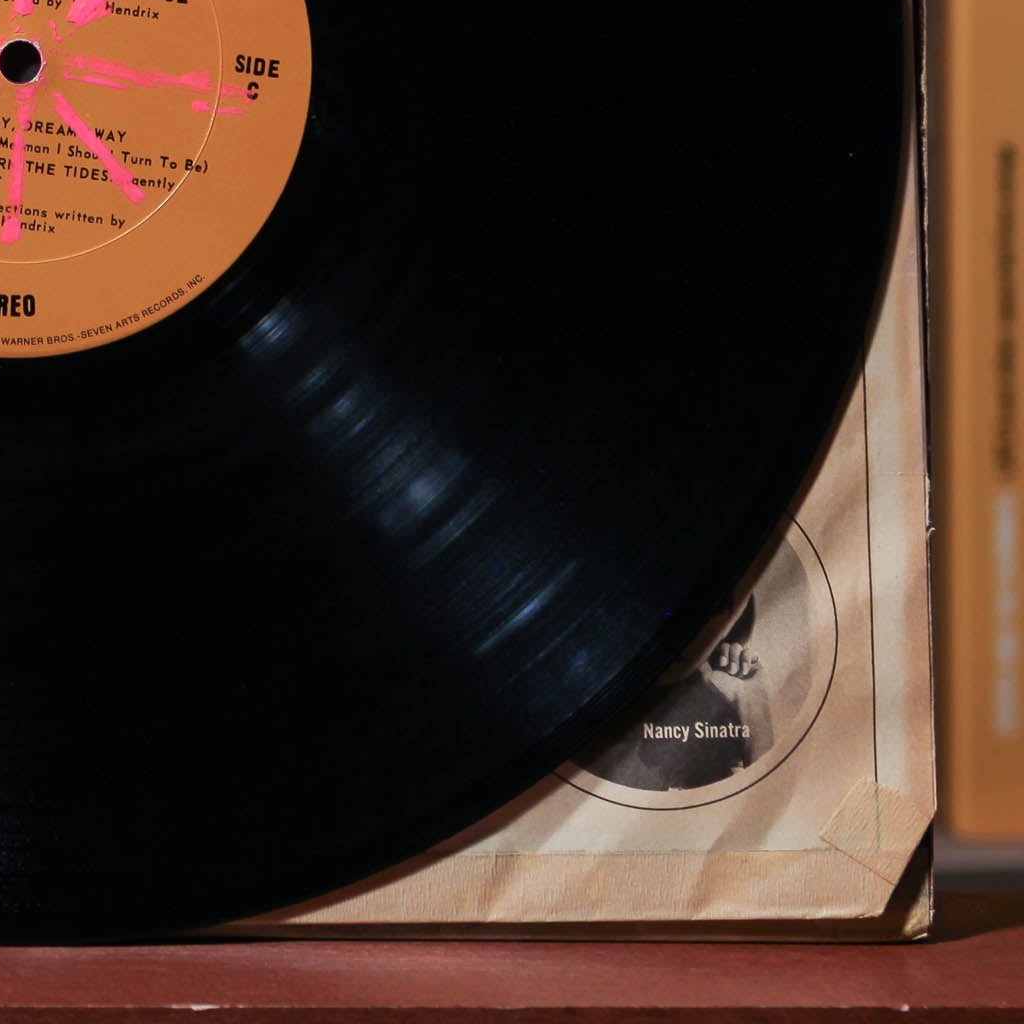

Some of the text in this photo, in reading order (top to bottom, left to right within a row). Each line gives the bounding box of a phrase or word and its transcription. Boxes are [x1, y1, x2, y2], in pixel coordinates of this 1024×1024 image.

[106, 2, 160, 20] Hendrix
[235, 54, 281, 79] SIDE
[93, 127, 127, 143] WAY
[0, 136, 50, 154] Meman
[68, 145, 113, 161] Shou
[121, 151, 152, 167] Turn
[160, 156, 178, 170] To
[185, 158, 209, 174] Be)
[26, 160, 57, 176] THE
[1, 215, 56, 234] ndrix
[55, 210, 104, 225] written
[111, 214, 126, 229] by
[1, 336, 44, 346] WARNER
[116, 313, 141, 329] ARTS
[187, 274, 206, 290] INC.
[643, 721, 751, 743] Nancy Sinatra
